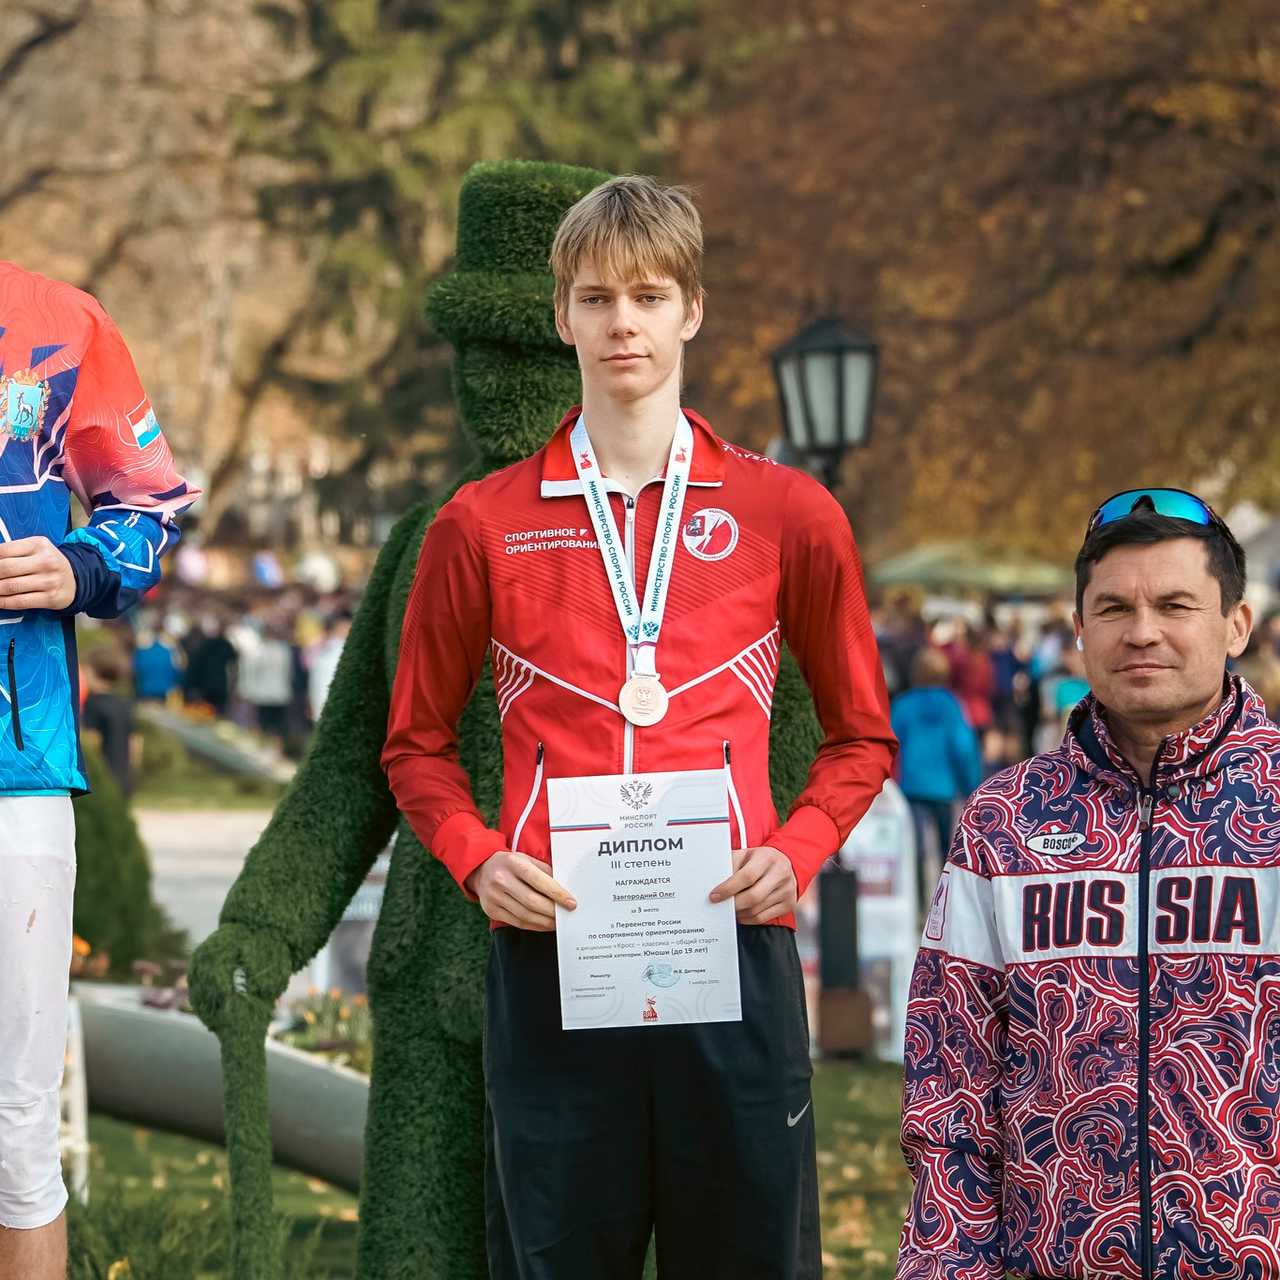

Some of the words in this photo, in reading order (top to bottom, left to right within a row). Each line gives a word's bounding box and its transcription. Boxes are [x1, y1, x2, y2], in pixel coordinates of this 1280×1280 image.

[505, 529, 576, 542] СПОРТИВНОЕ
[506, 539, 600, 554] ОРИЕНТИРОВАНИ
[589, 481, 613, 545] МИНИСТЕРСТВО
[608, 546, 622, 579] СПОРТА
[618, 581, 633, 616] РОССИИ
[650, 546, 668, 611] МИНИСТЕРСТВО
[663, 512, 675, 544] СПОРТА
[669, 475, 681, 509] РОССИИ
[598, 837, 683, 856] ДИПЛОМ
[611, 861, 621, 869] III
[624, 859, 671, 868] степень
[615, 877, 670, 886] НАГРАЖДАЕТСЯ
[613, 892, 657, 901] Завгородний
[645, 928, 705, 937] ориентированию
